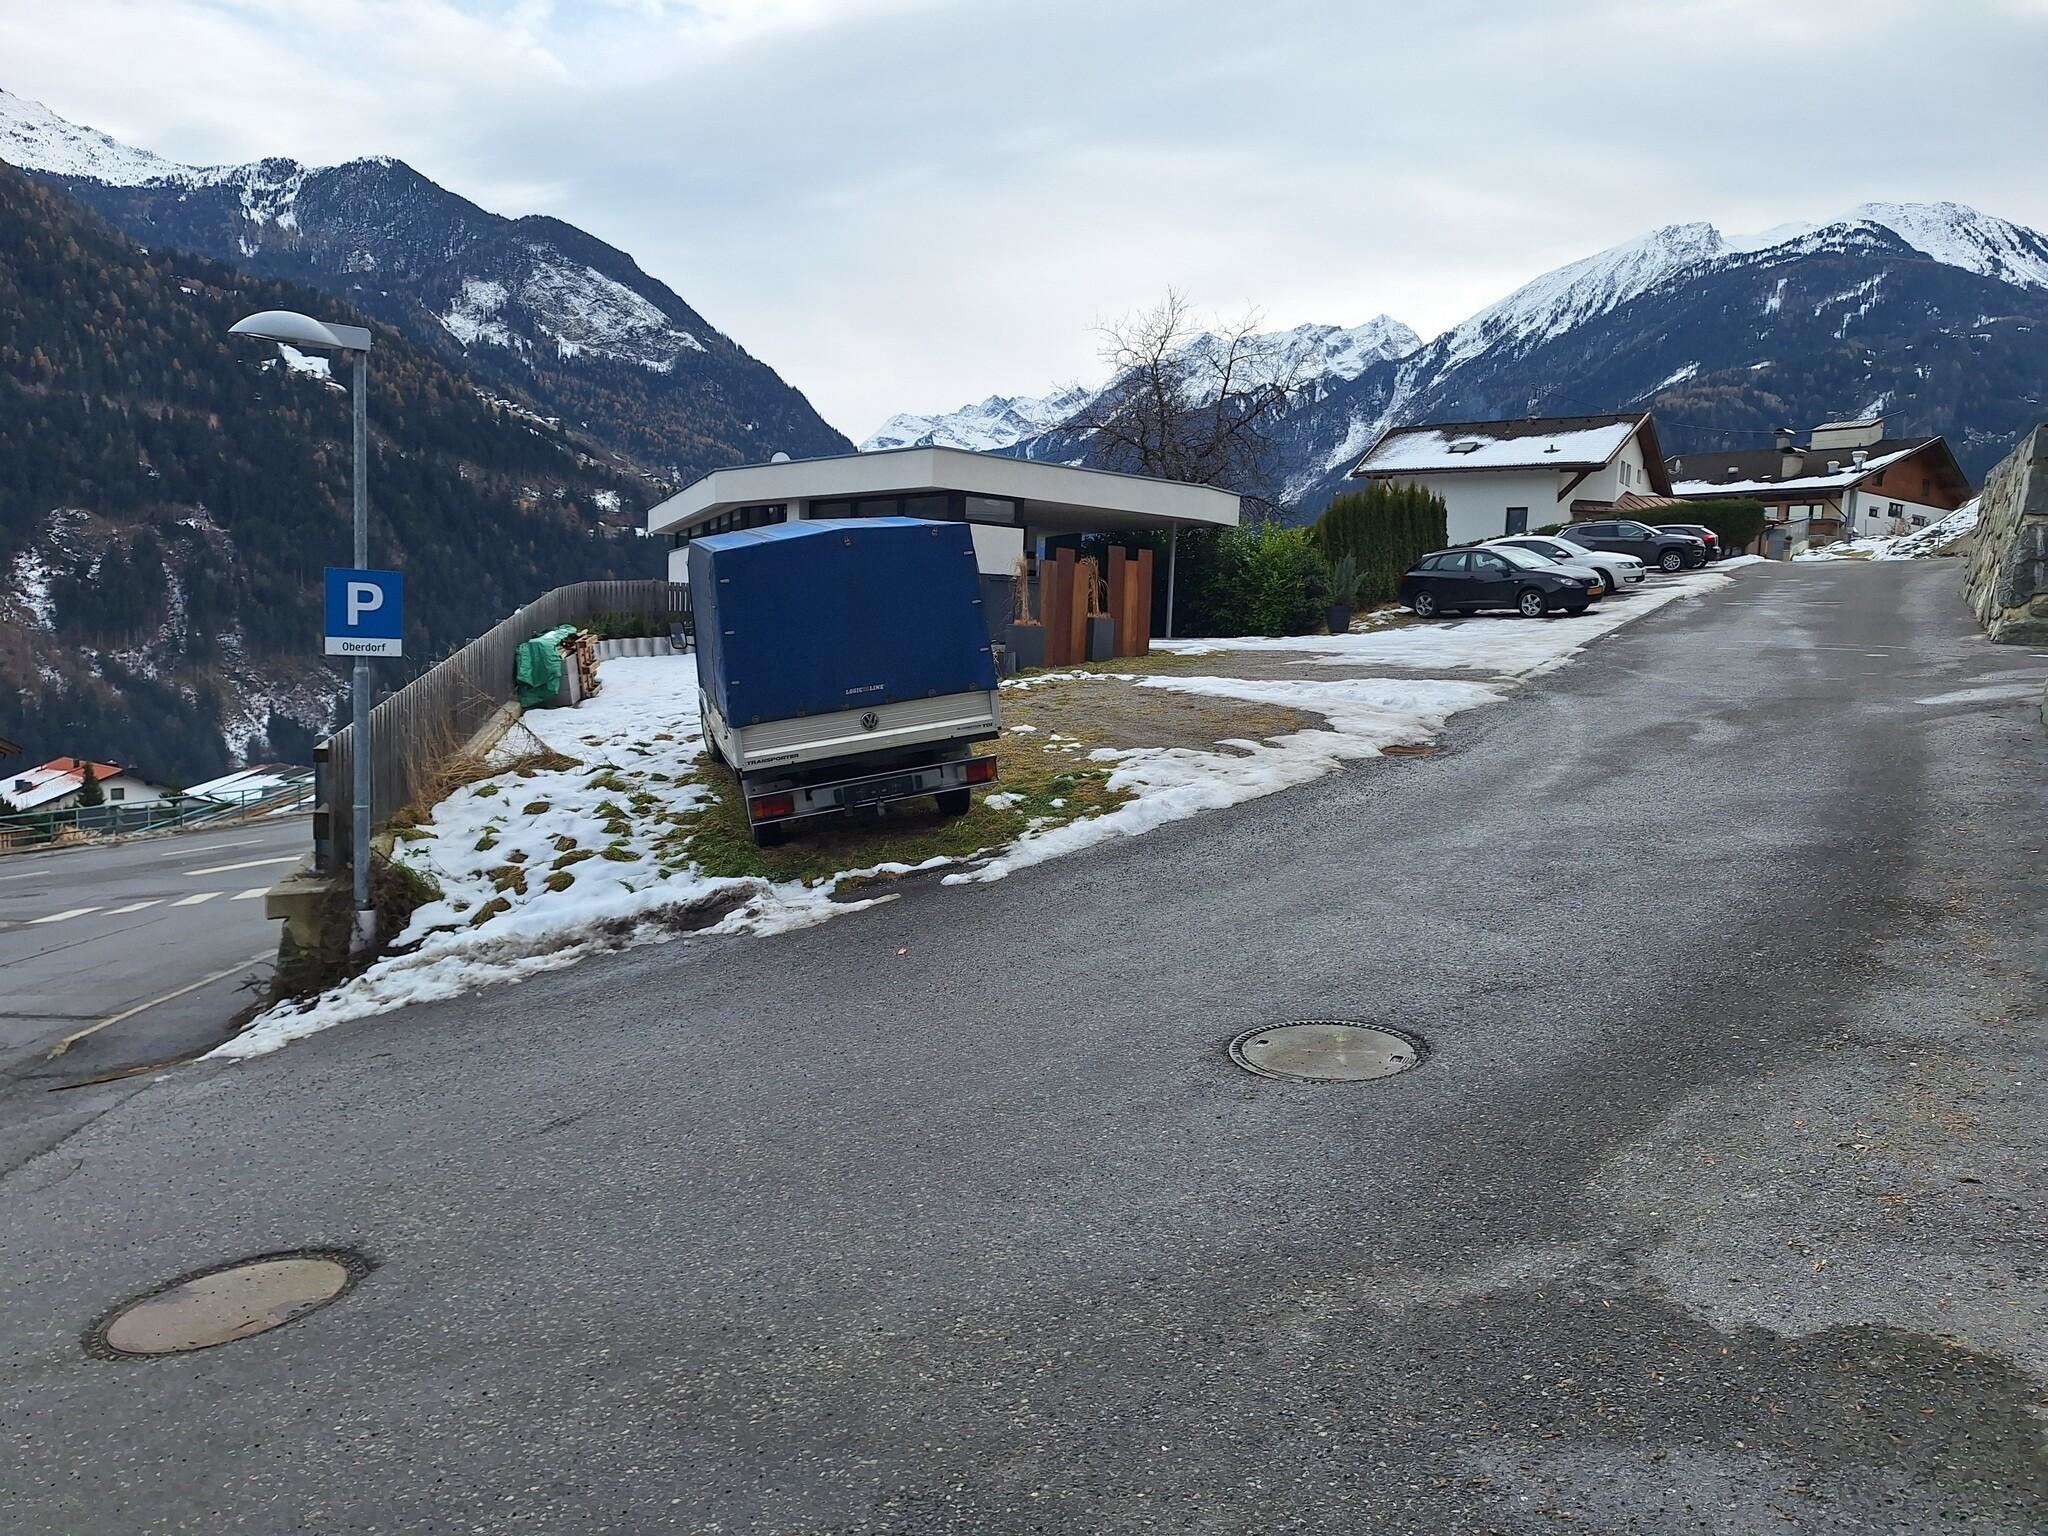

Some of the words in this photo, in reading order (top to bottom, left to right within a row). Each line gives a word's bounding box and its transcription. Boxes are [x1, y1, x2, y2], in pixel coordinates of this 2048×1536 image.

[347, 581, 384, 626] P
[342, 642, 386, 652] Oberdorf
[746, 753, 799, 766] TRANSPORTER
